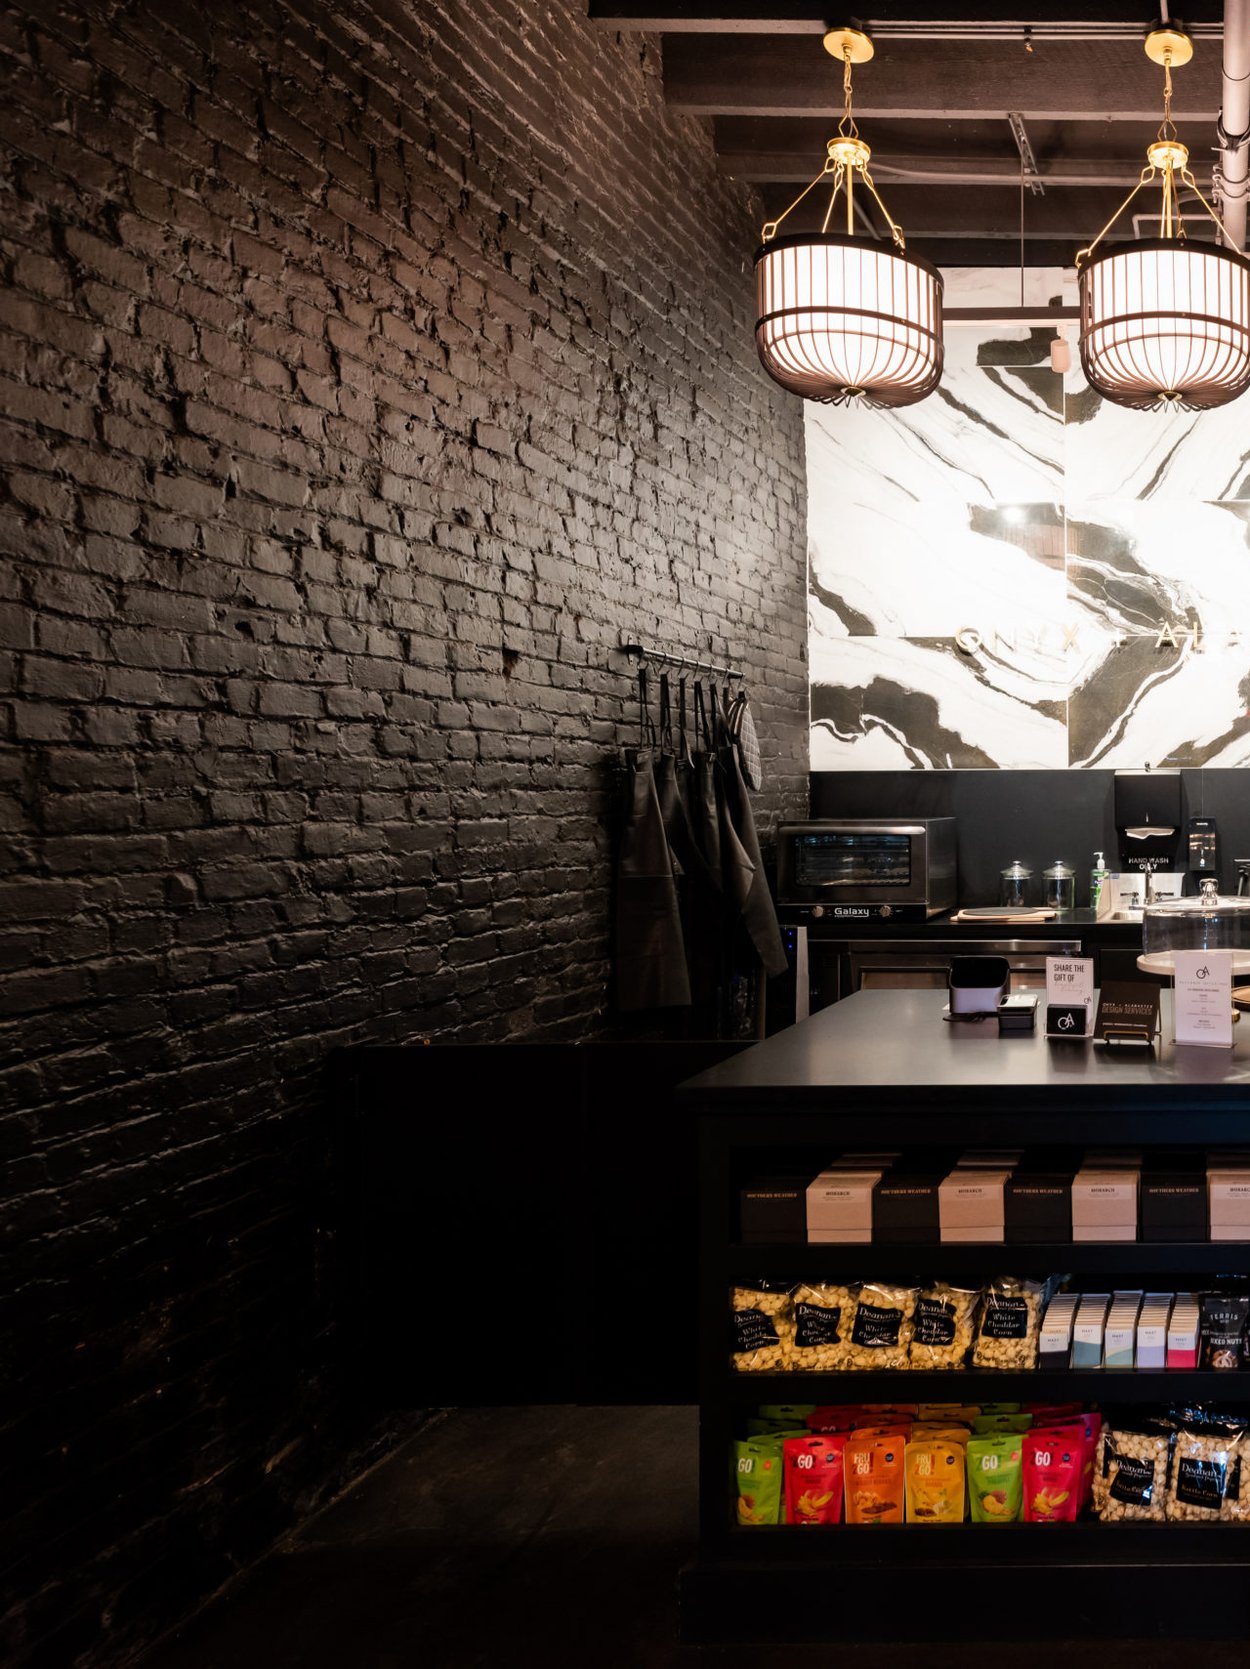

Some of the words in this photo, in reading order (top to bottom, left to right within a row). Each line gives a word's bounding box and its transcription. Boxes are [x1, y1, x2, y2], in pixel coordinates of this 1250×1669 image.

[834, 907, 869, 917] Galaxy
[1054, 964, 1072, 972] SHARE
[1074, 965, 1084, 973] THE
[1068, 974, 1075, 982] OF
